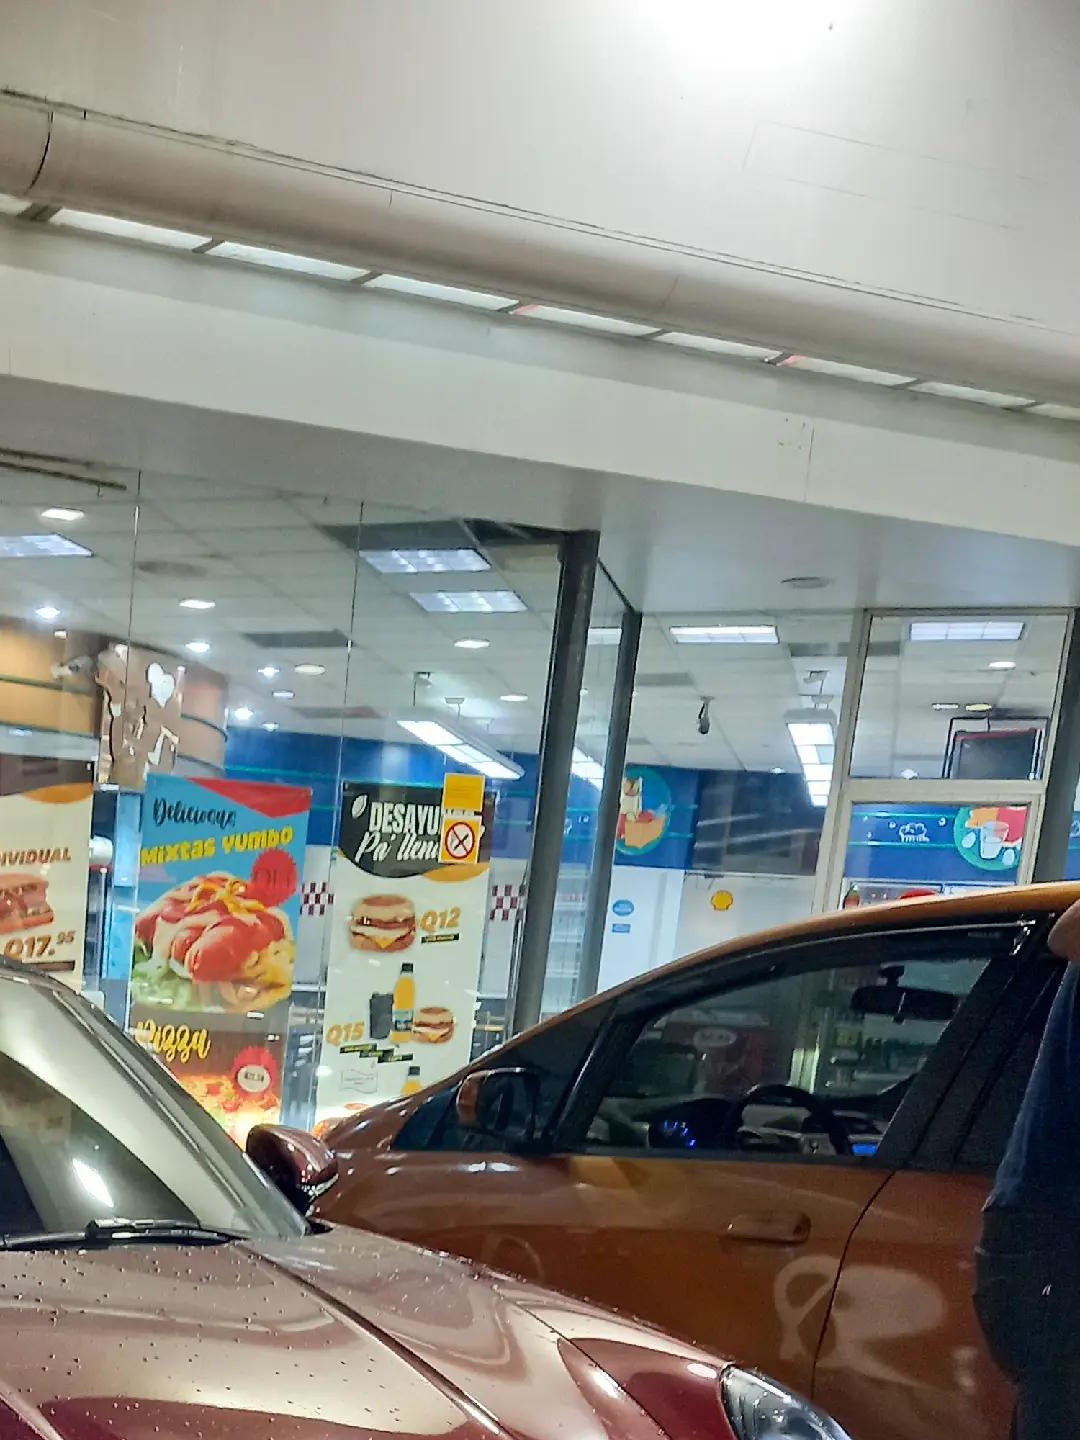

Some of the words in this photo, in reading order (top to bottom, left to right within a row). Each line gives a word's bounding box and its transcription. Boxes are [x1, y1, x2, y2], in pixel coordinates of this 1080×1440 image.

[369, 802, 441, 835] DESAYU
[420, 907, 461, 932] Q12
[327, 1022, 365, 1047] Q15
